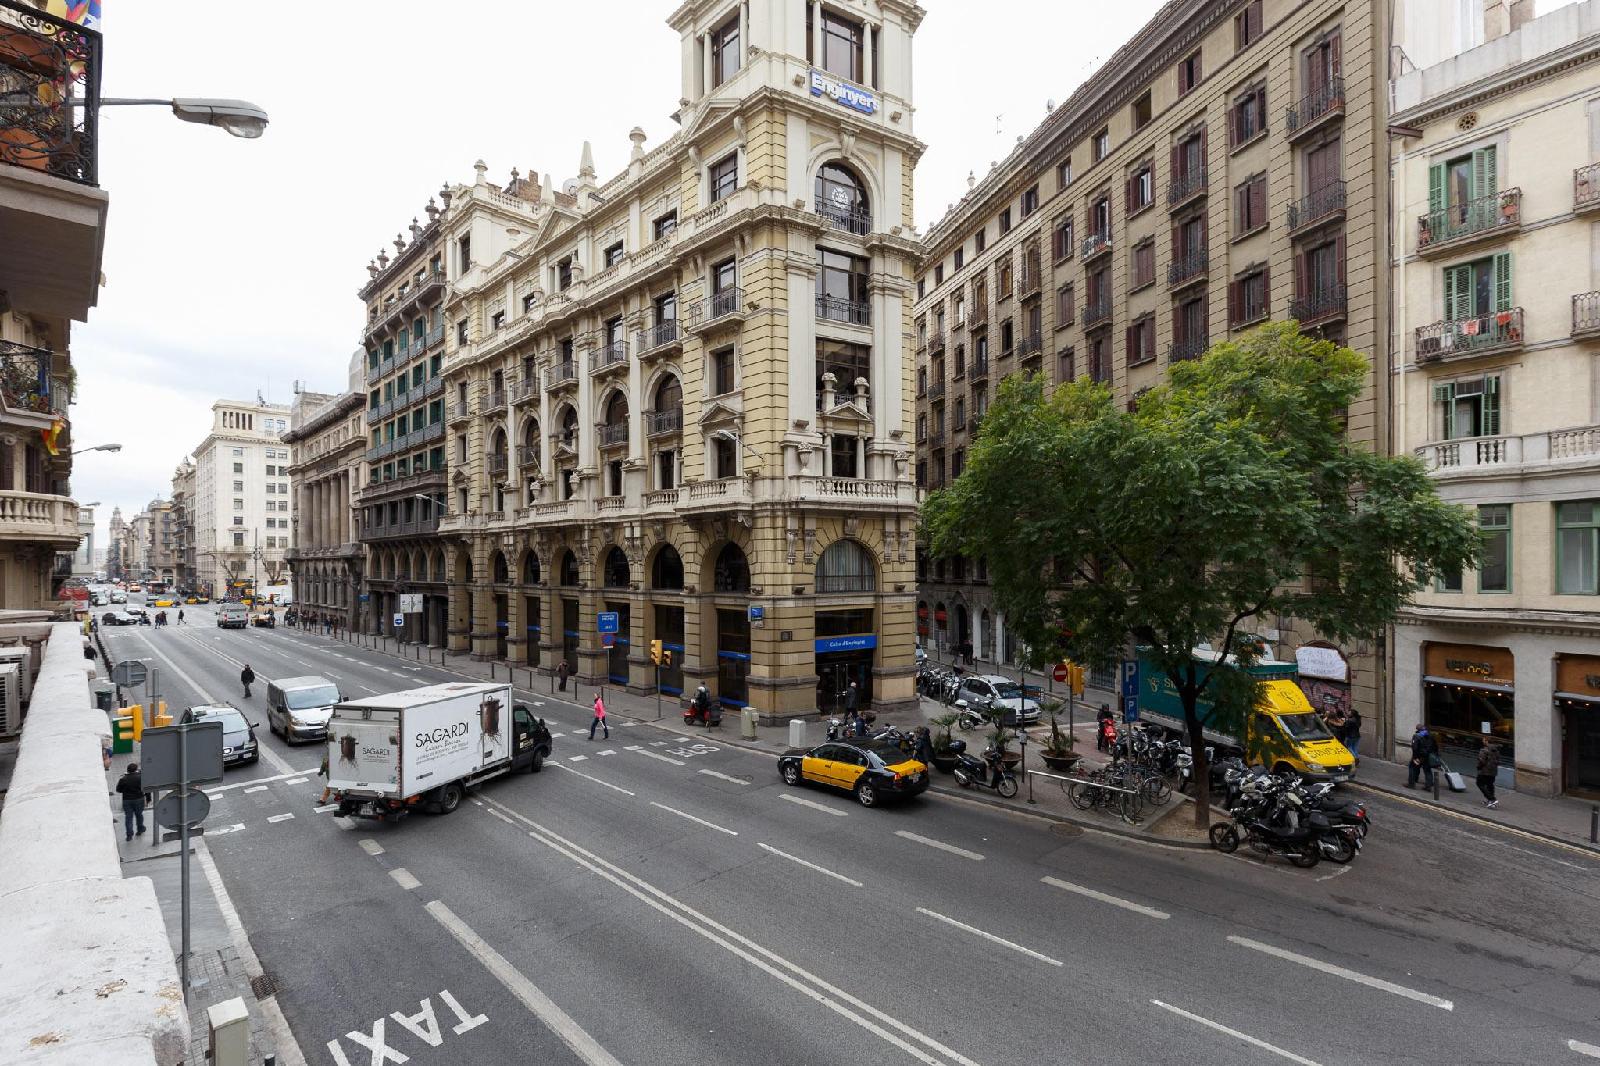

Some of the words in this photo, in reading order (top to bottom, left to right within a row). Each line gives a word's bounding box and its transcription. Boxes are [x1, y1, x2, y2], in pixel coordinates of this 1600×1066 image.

[1125, 662, 1136, 682] P
[1128, 700, 1134, 710] P
[415, 722, 469, 748] SAGARDI
[362, 747, 390, 756] SAGARDI
[326, 989, 489, 1066] TAXI
